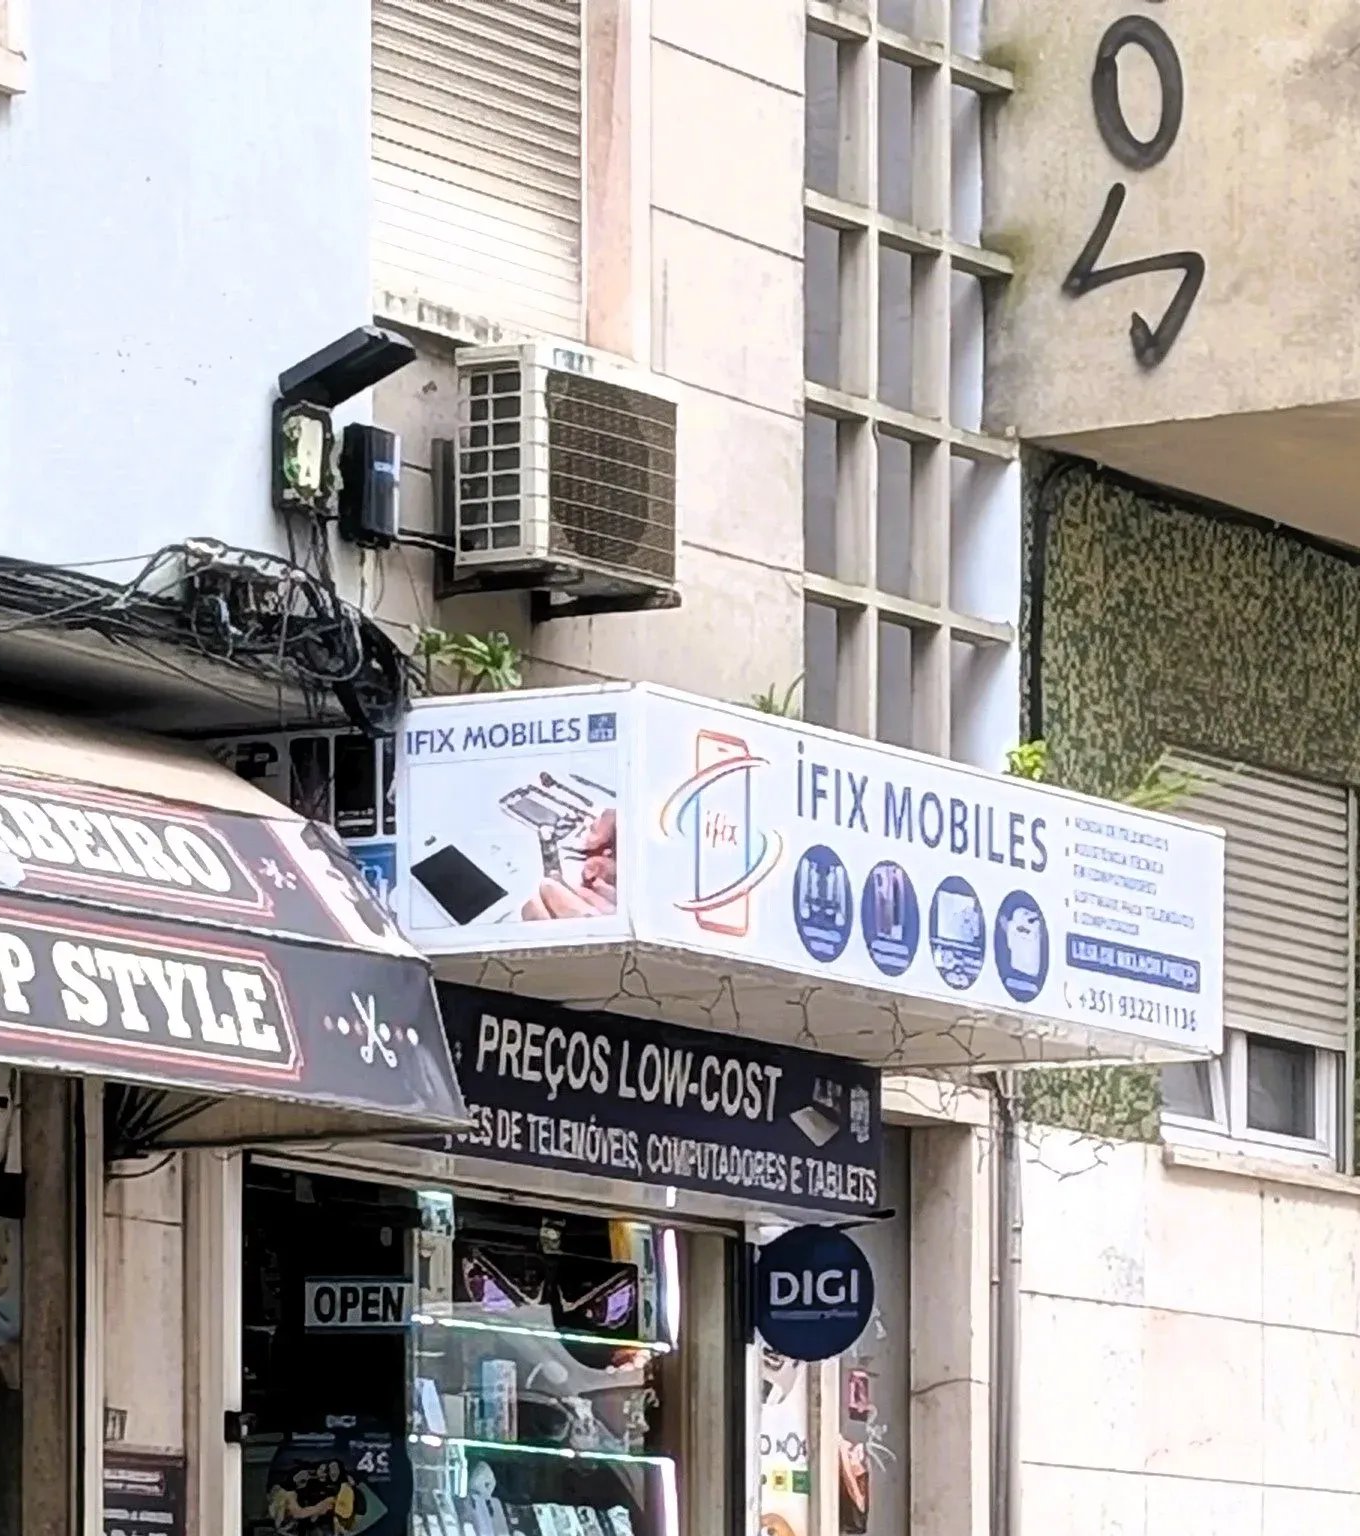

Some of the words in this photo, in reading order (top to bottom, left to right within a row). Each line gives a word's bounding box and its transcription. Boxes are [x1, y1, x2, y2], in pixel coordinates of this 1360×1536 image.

[463, 717, 581, 751] MOBILES
[884, 781, 1048, 873] MOBILES
[52, 943, 282, 1052] STYLE
[475, 1014, 612, 1100] PREÇOS
[619, 1041, 783, 1122] LOW-COST
[497, 1109, 522, 1151] DE
[647, 1134, 787, 1193] COMPUTADORES
[790, 1158, 803, 1195] E
[806, 1158, 878, 1206] TABLETS
[314, 1286, 404, 1323] OPEN
[770, 1268, 859, 1306] DIGI
